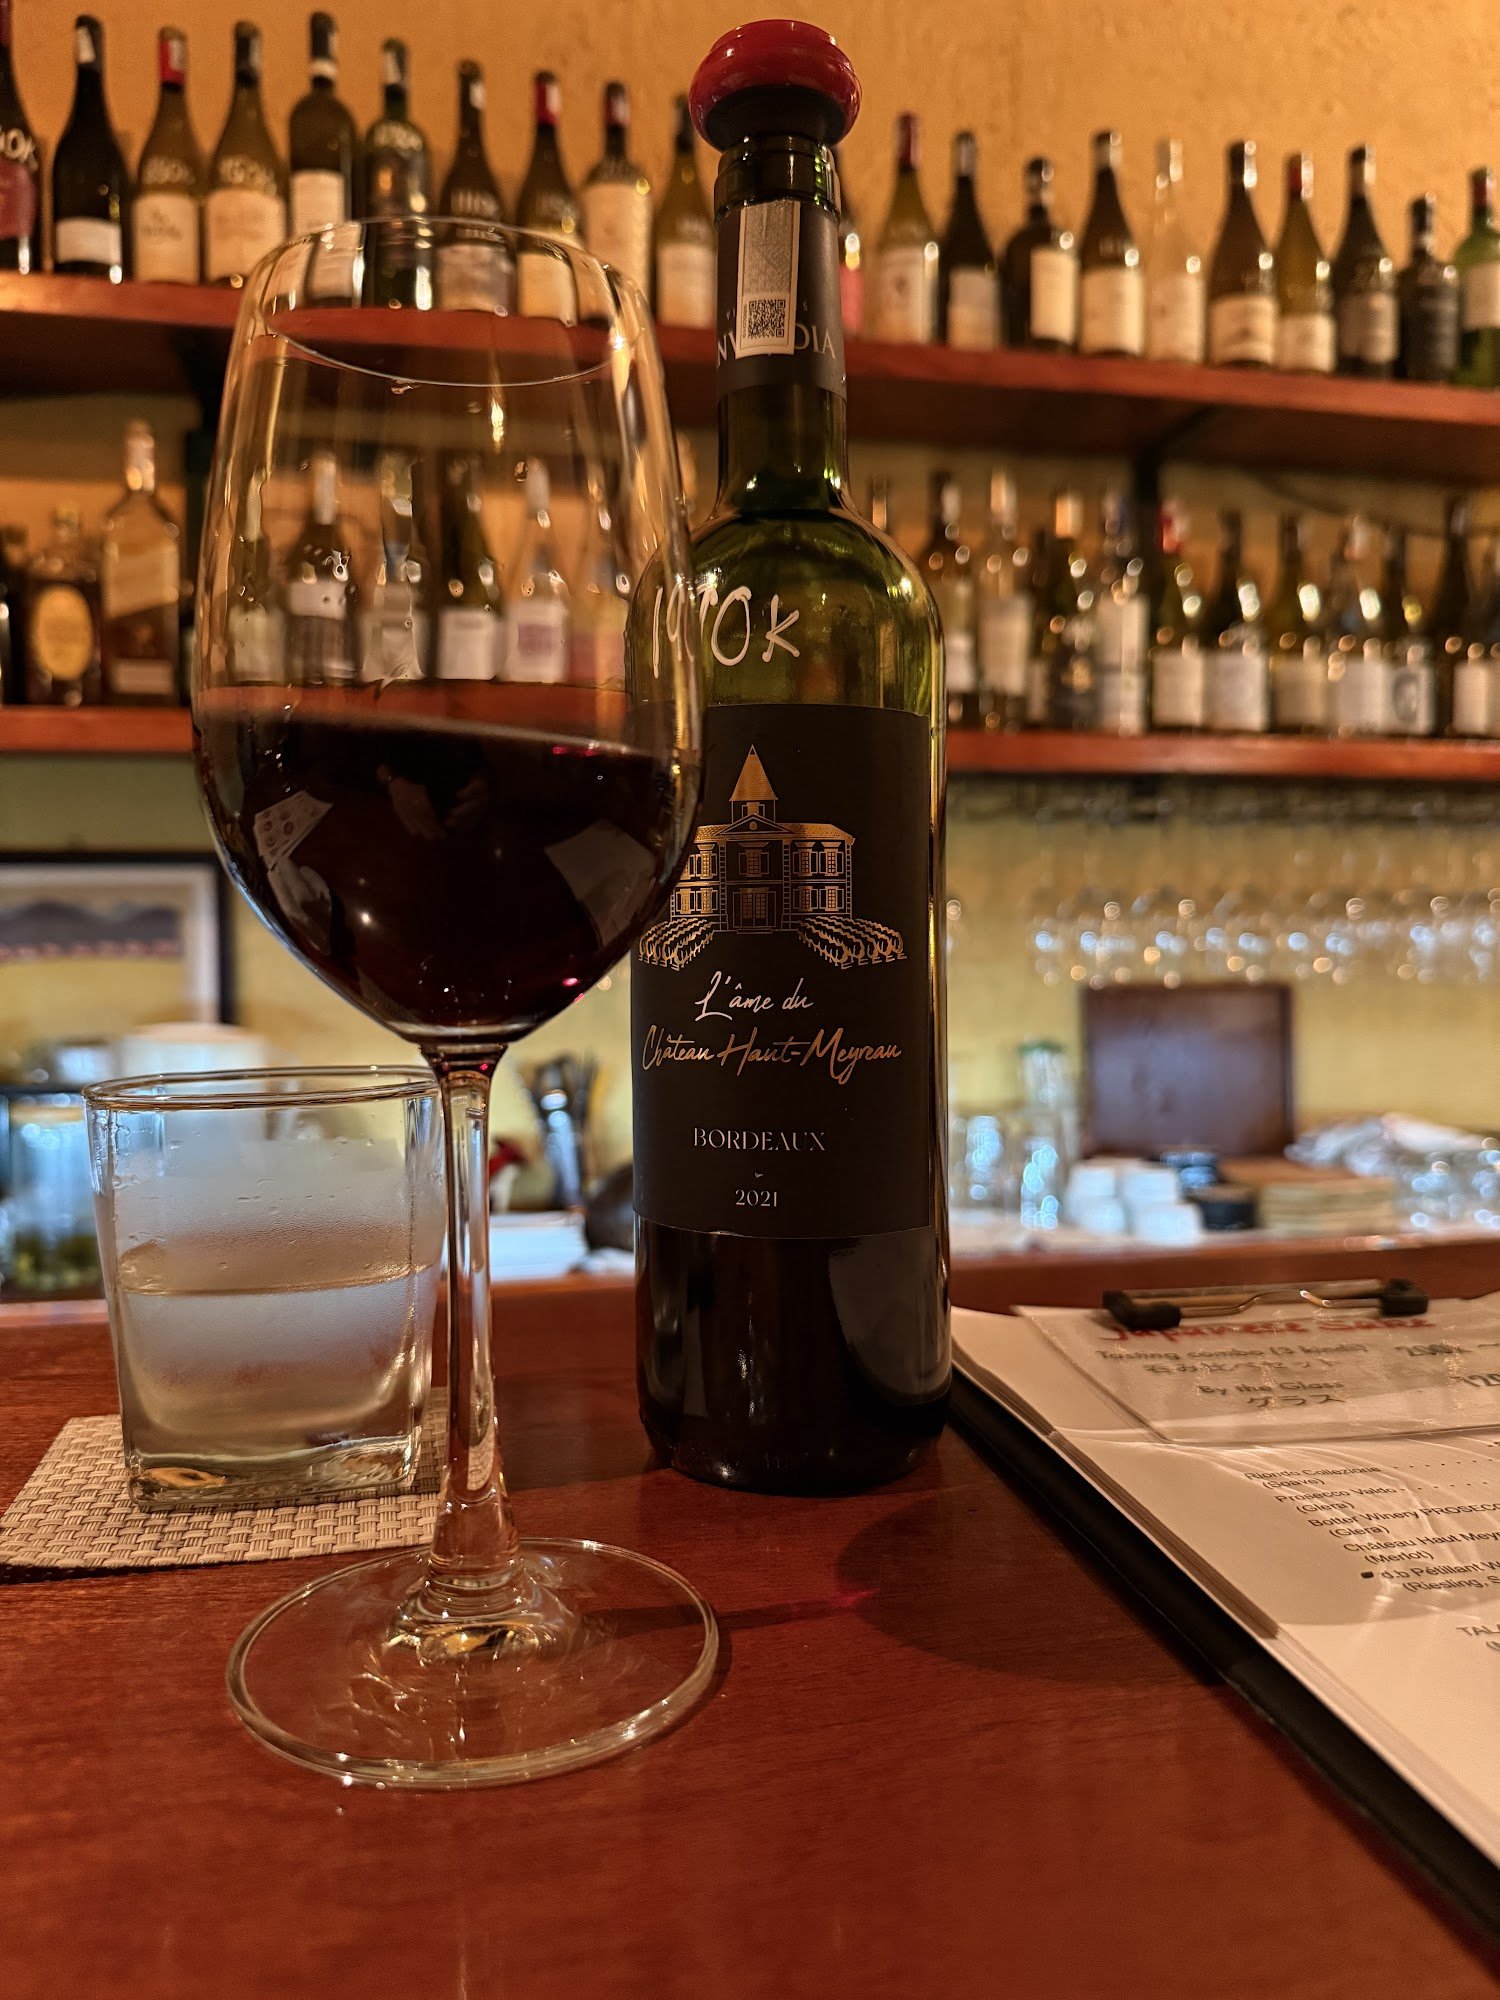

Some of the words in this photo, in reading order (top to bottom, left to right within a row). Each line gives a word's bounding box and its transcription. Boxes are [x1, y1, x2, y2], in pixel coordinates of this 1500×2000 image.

[695, 970, 773, 1021] L'âme
[782, 978, 813, 1011] du
[642, 1025, 715, 1070] Château
[717, 1027, 901, 1084] Haut-Meyreau
[693, 1127, 826, 1151] BORDEAUX
[735, 1189, 778, 1208] 2021
[1198, 1385, 1227, 1396] By
[1235, 1383, 1272, 1393] the
[1279, 1380, 1345, 1390] Glass
[1262, 1478, 1325, 1490] (Soave)
[1275, 1491, 1351, 1503] Prosecco
[1296, 1501, 1355, 1514] (Glera)
[1308, 1516, 1359, 1528] Botter
[1360, 1509, 1420, 1521] Winery
[1329, 1525, 1390, 1538] (Glera)
[1343, 1539, 1417, 1552] Château
[1417, 1534, 1462, 1546] Haut
[1364, 1550, 1434, 1564] (Merlot)
[1410, 1563, 1484, 1577] Pétillant
[1402, 1577, 1489, 1592] (Riesling,
